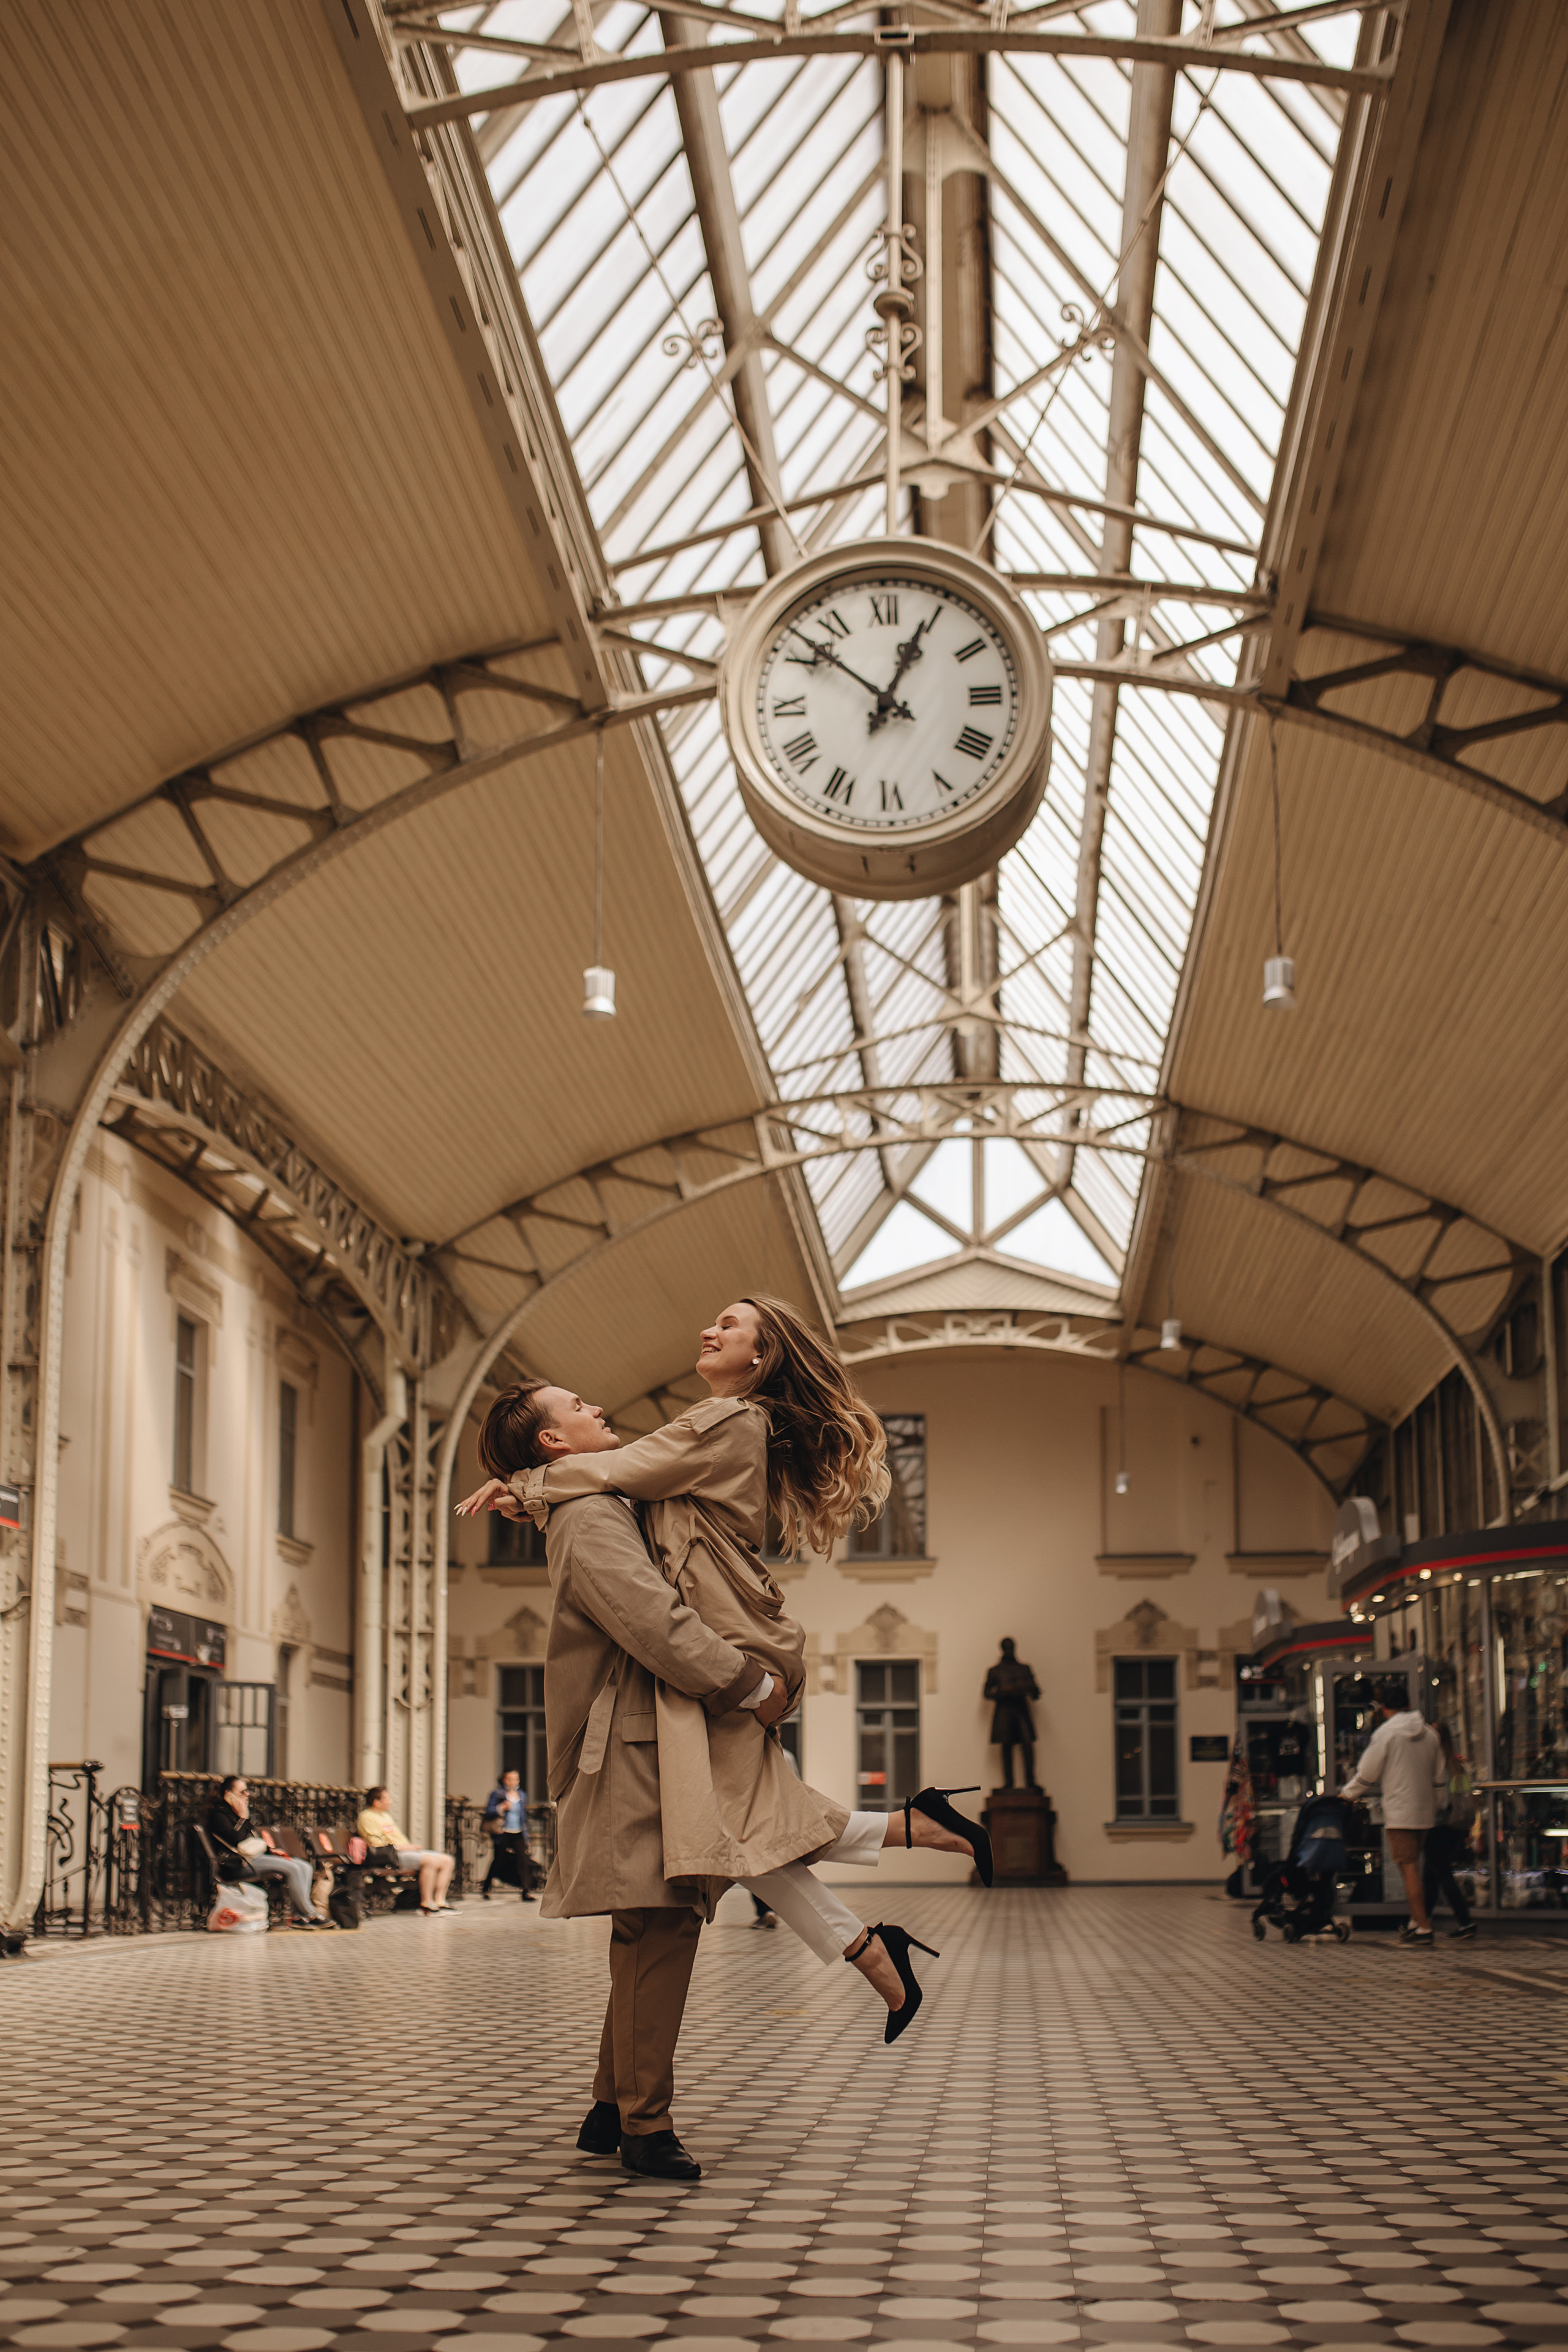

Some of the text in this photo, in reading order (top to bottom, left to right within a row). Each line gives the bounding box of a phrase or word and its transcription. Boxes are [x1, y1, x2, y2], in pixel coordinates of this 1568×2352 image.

[817, 609, 851, 643] XI
[870, 595, 899, 627] XII
[925, 605, 944, 633] I
[953, 638, 987, 663] II
[772, 696, 806, 718] IX
[968, 685, 1002, 706] III
[782, 731, 821, 775] VIII
[954, 726, 993, 760] IIII
[823, 767, 856, 806] VII
[880, 780, 904, 812] VI
[931, 770, 953, 796] V
